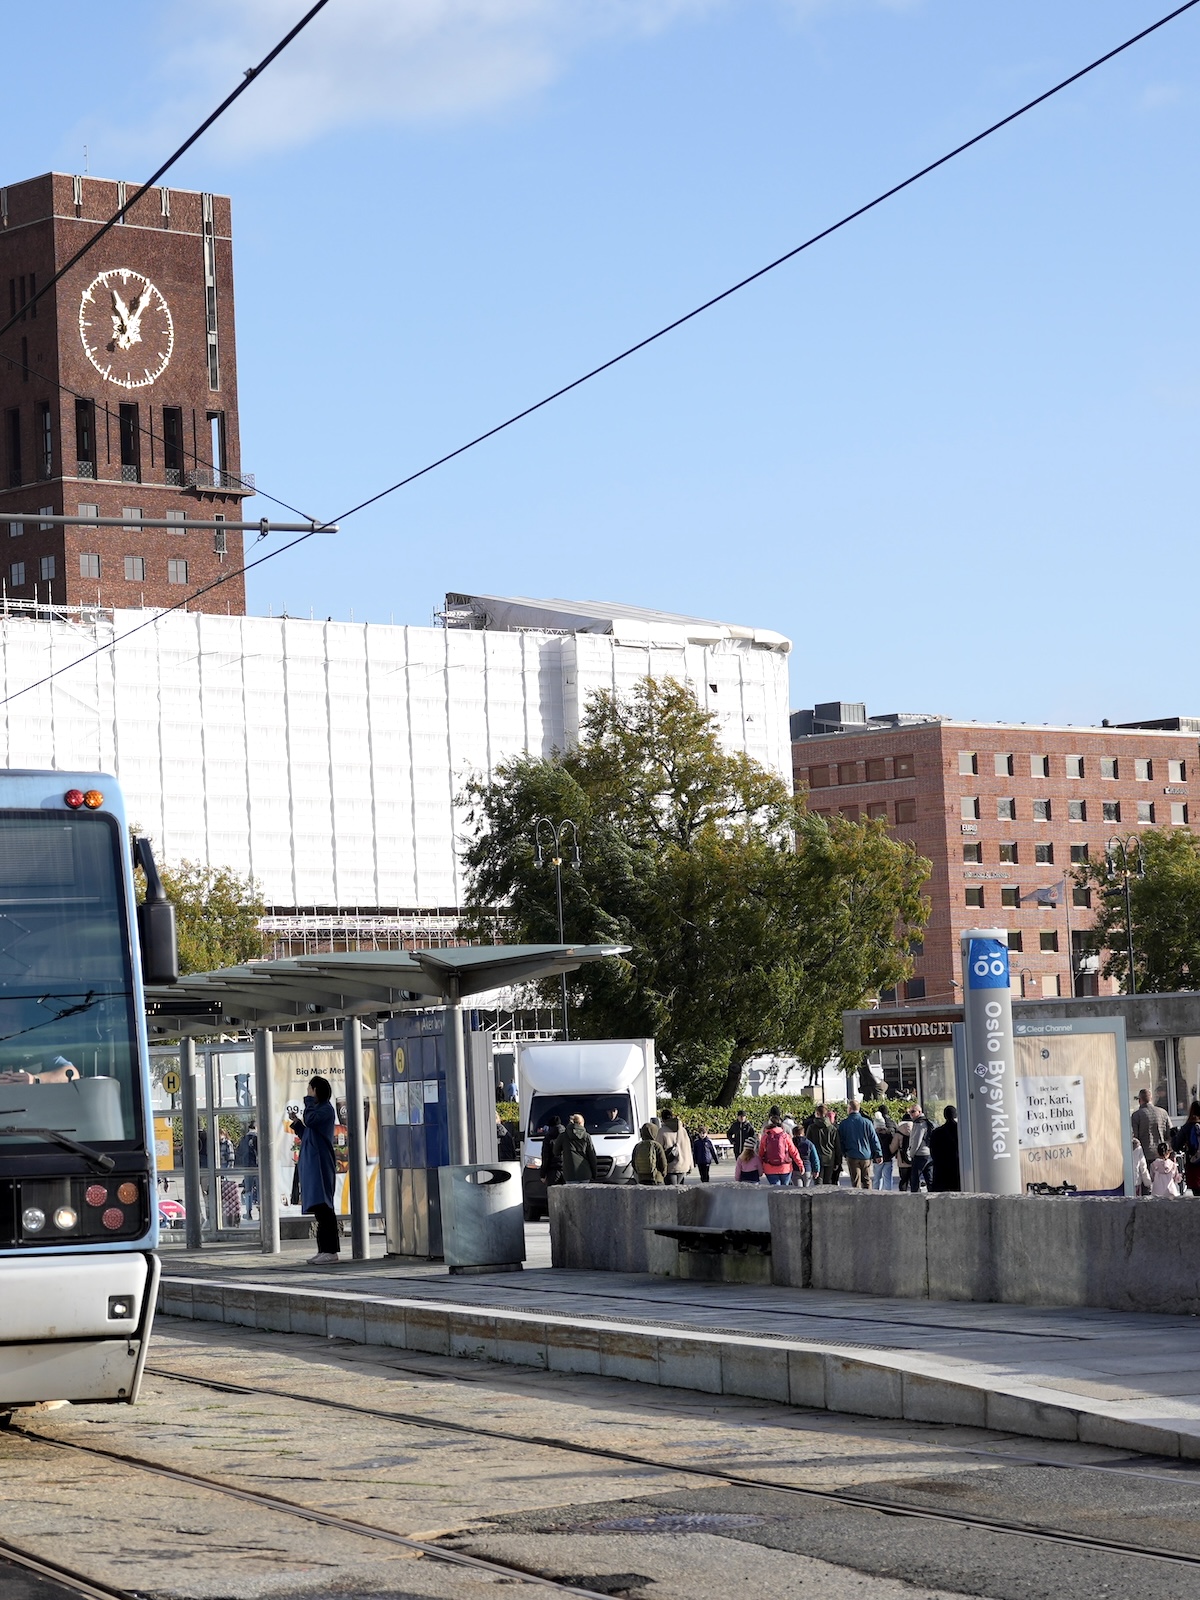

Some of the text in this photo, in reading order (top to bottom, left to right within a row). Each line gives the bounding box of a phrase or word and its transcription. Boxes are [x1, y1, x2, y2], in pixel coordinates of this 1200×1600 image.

[868, 1021, 954, 1039] FISKETORGET
[1026, 1024, 1073, 1033] Clear Channel
[295, 1067, 309, 1077] Big
[310, 1067, 327, 1075] Mac
[167, 1076, 176, 1089] H
[984, 1001, 1011, 1160] Oslo Bysykkel
[1026, 1093, 1072, 1107] Tor, Kari,
[1027, 1108, 1074, 1120] Eva, Ebba
[1026, 1120, 1076, 1137] og Øyvind
[1028, 1147, 1073, 1162] OG NORA
